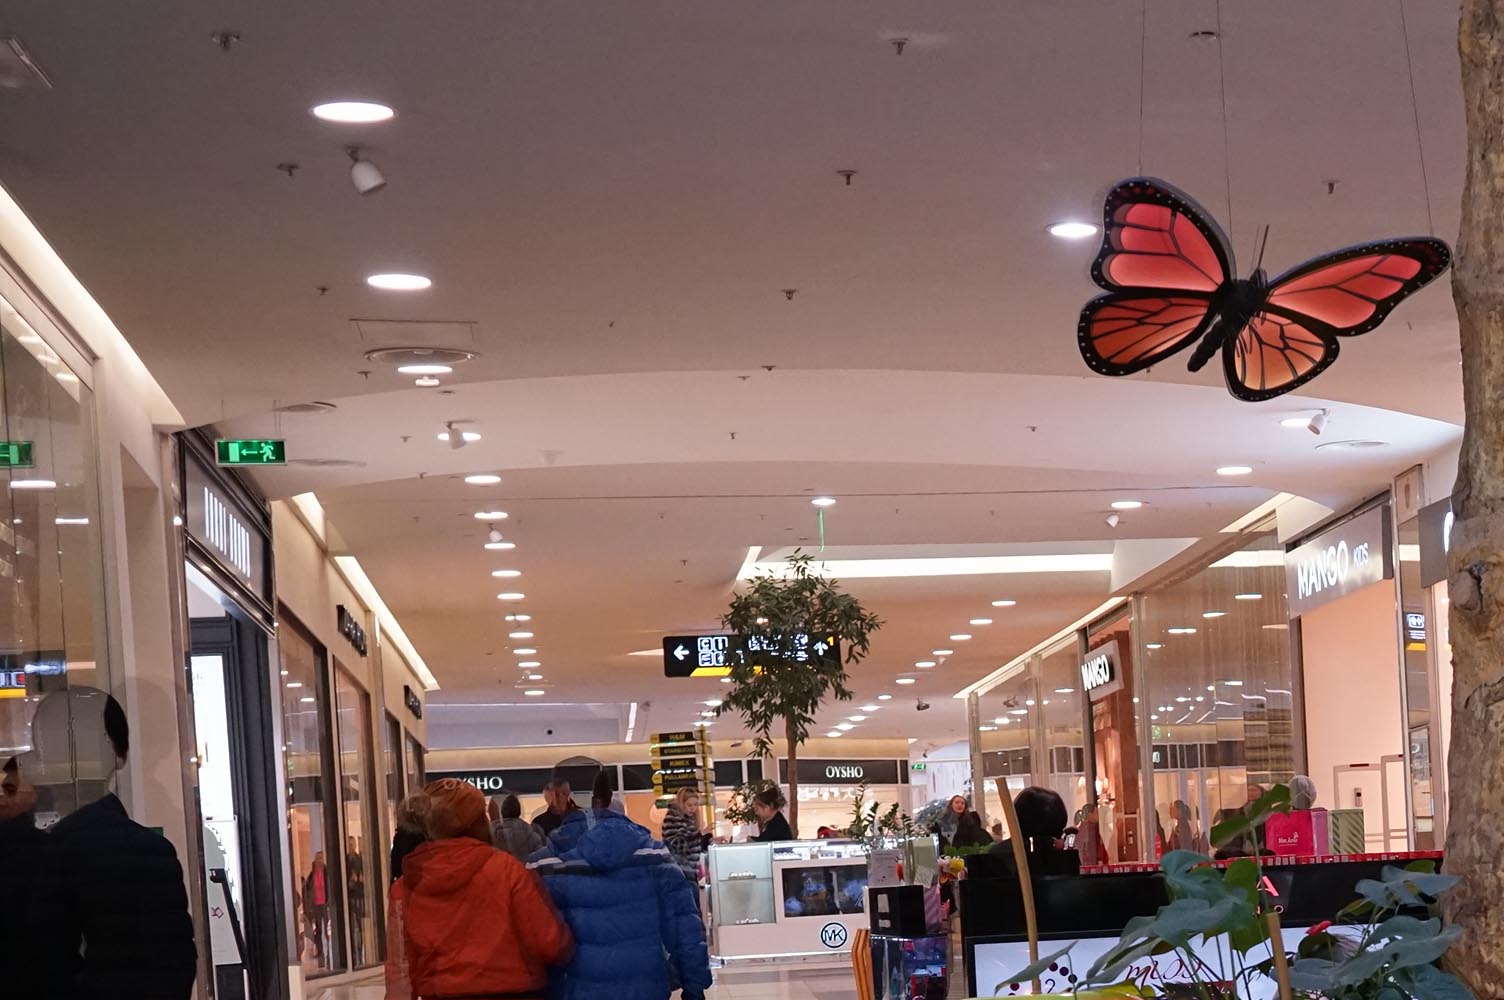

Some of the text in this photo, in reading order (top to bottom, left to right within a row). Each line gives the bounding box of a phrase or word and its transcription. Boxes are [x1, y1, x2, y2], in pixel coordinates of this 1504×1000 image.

[1297, 540, 1369, 600] MANGO KIDS
[1081, 654, 1110, 691] MANGO
[825, 765, 864, 778] OYSHO
